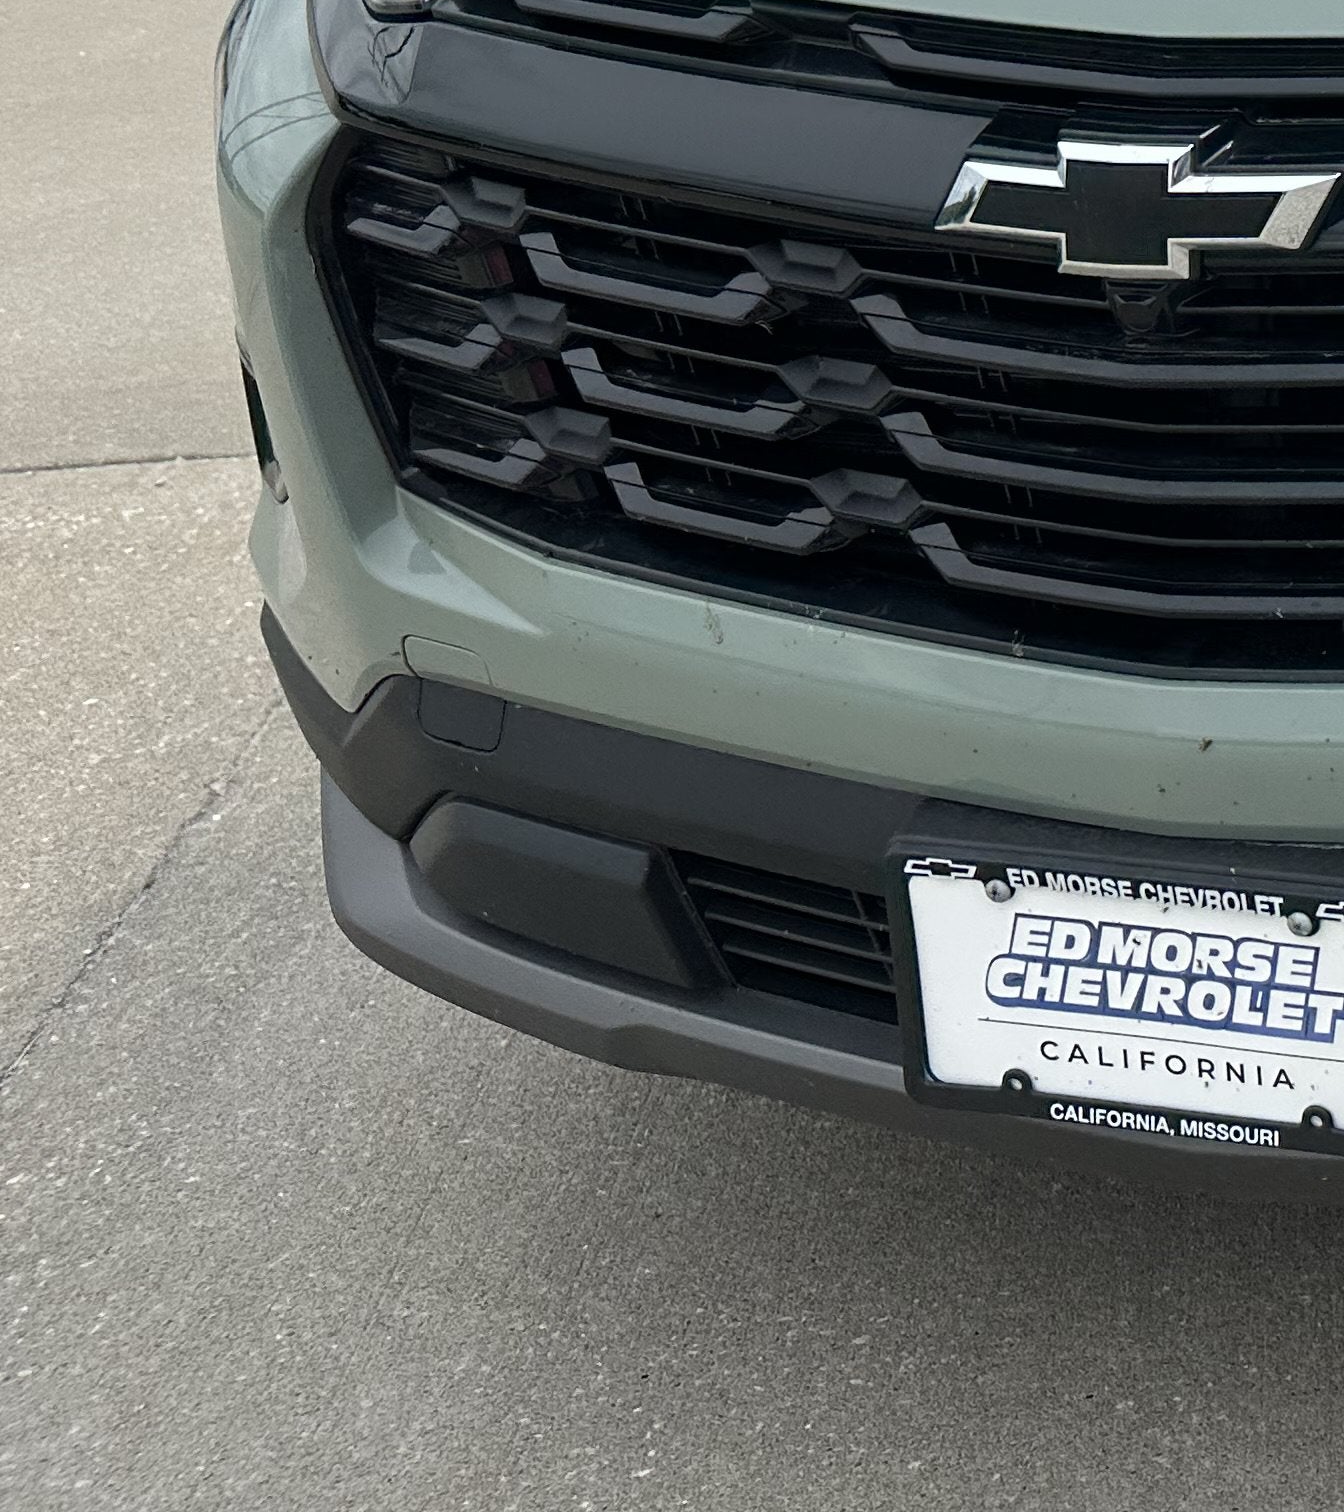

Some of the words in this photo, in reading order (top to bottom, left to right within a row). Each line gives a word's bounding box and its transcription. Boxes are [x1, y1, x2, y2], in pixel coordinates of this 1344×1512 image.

[1006, 868, 1040, 889] ED
[1046, 872, 1134, 900] MORSE
[1140, 882, 1284, 917] CHEVROLET
[1010, 913, 1094, 962] ED
[1096, 921, 1320, 989] MORSE
[1040, 1040, 1295, 1090] CALIFORNIA
[1050, 1103, 1176, 1137] CALIFORNIA,
[1180, 1119, 1280, 1148] MISSOURI
